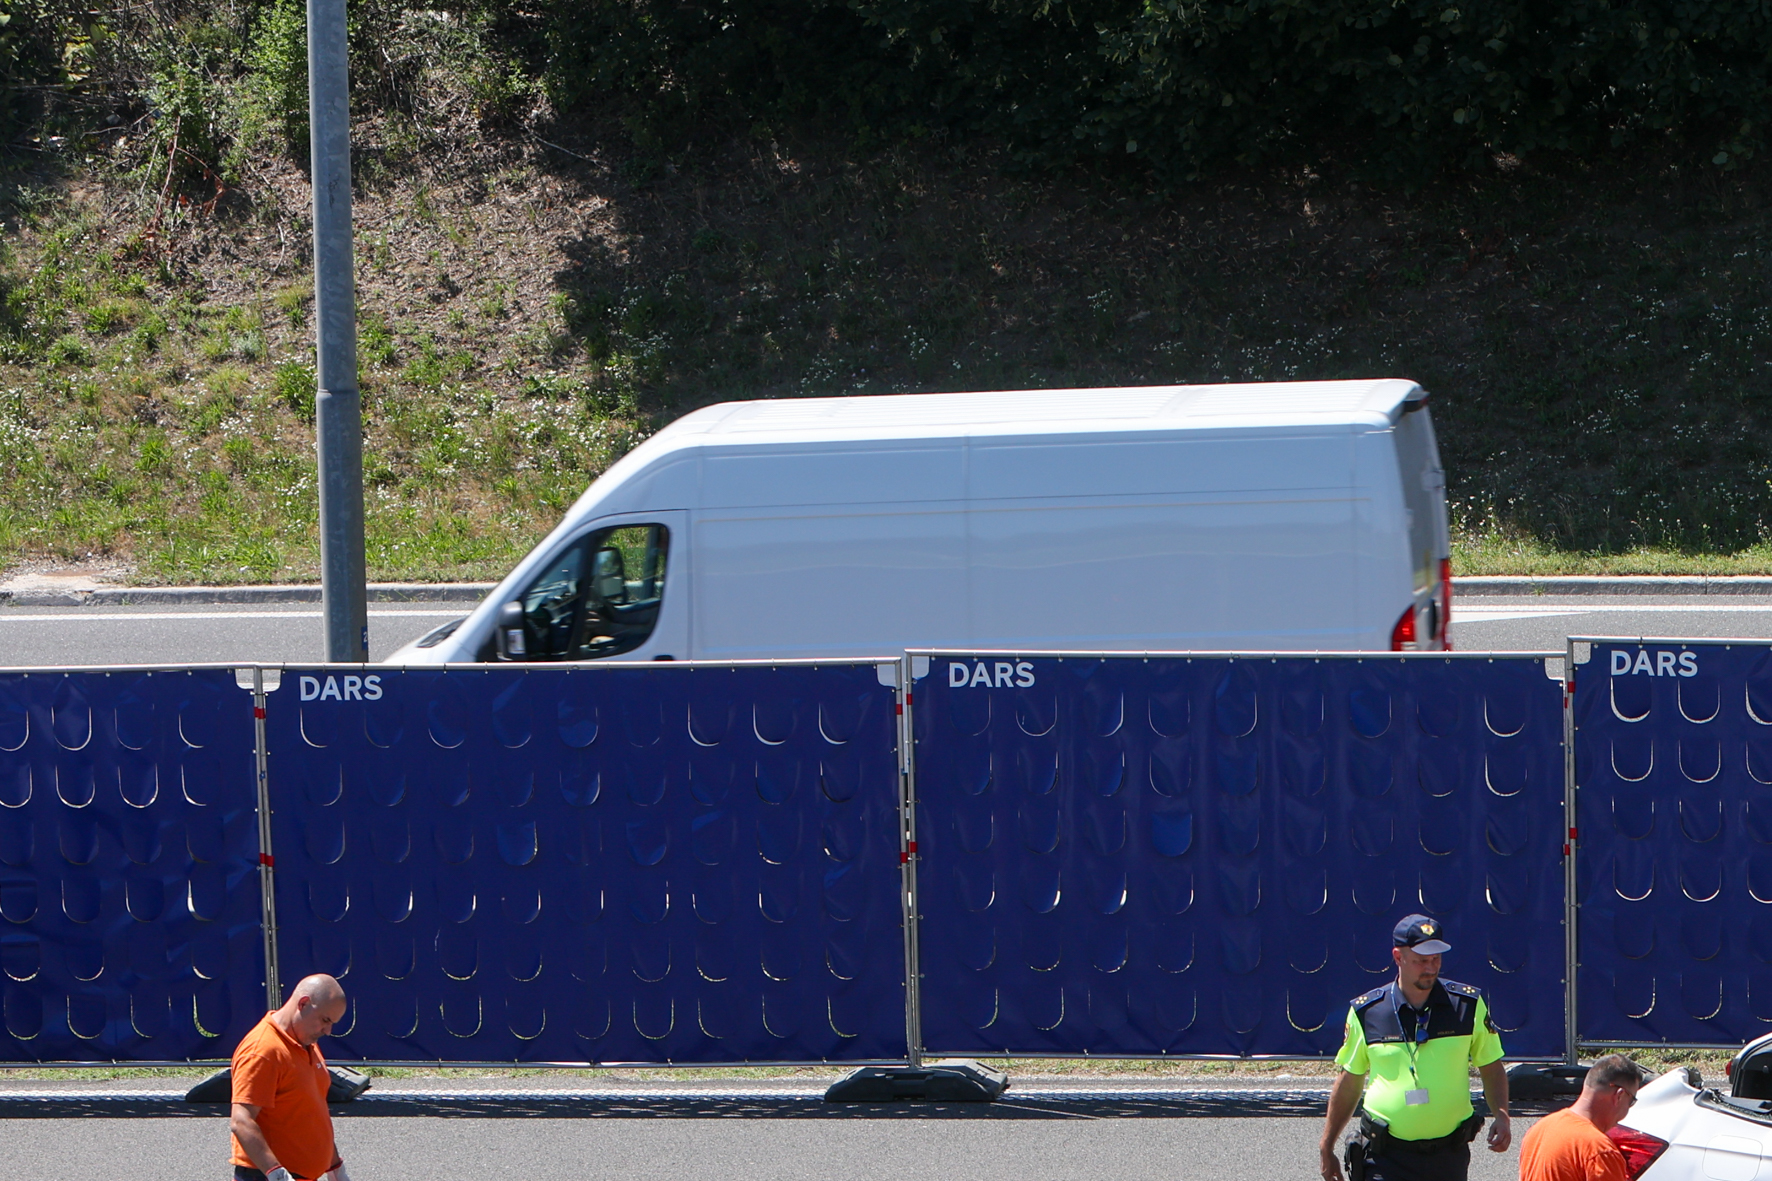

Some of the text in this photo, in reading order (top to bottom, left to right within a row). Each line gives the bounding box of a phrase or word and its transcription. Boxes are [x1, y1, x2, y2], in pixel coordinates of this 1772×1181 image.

[949, 662, 1035, 688] DARS
[1611, 650, 1698, 678] DARS
[299, 675, 383, 701] DARS
